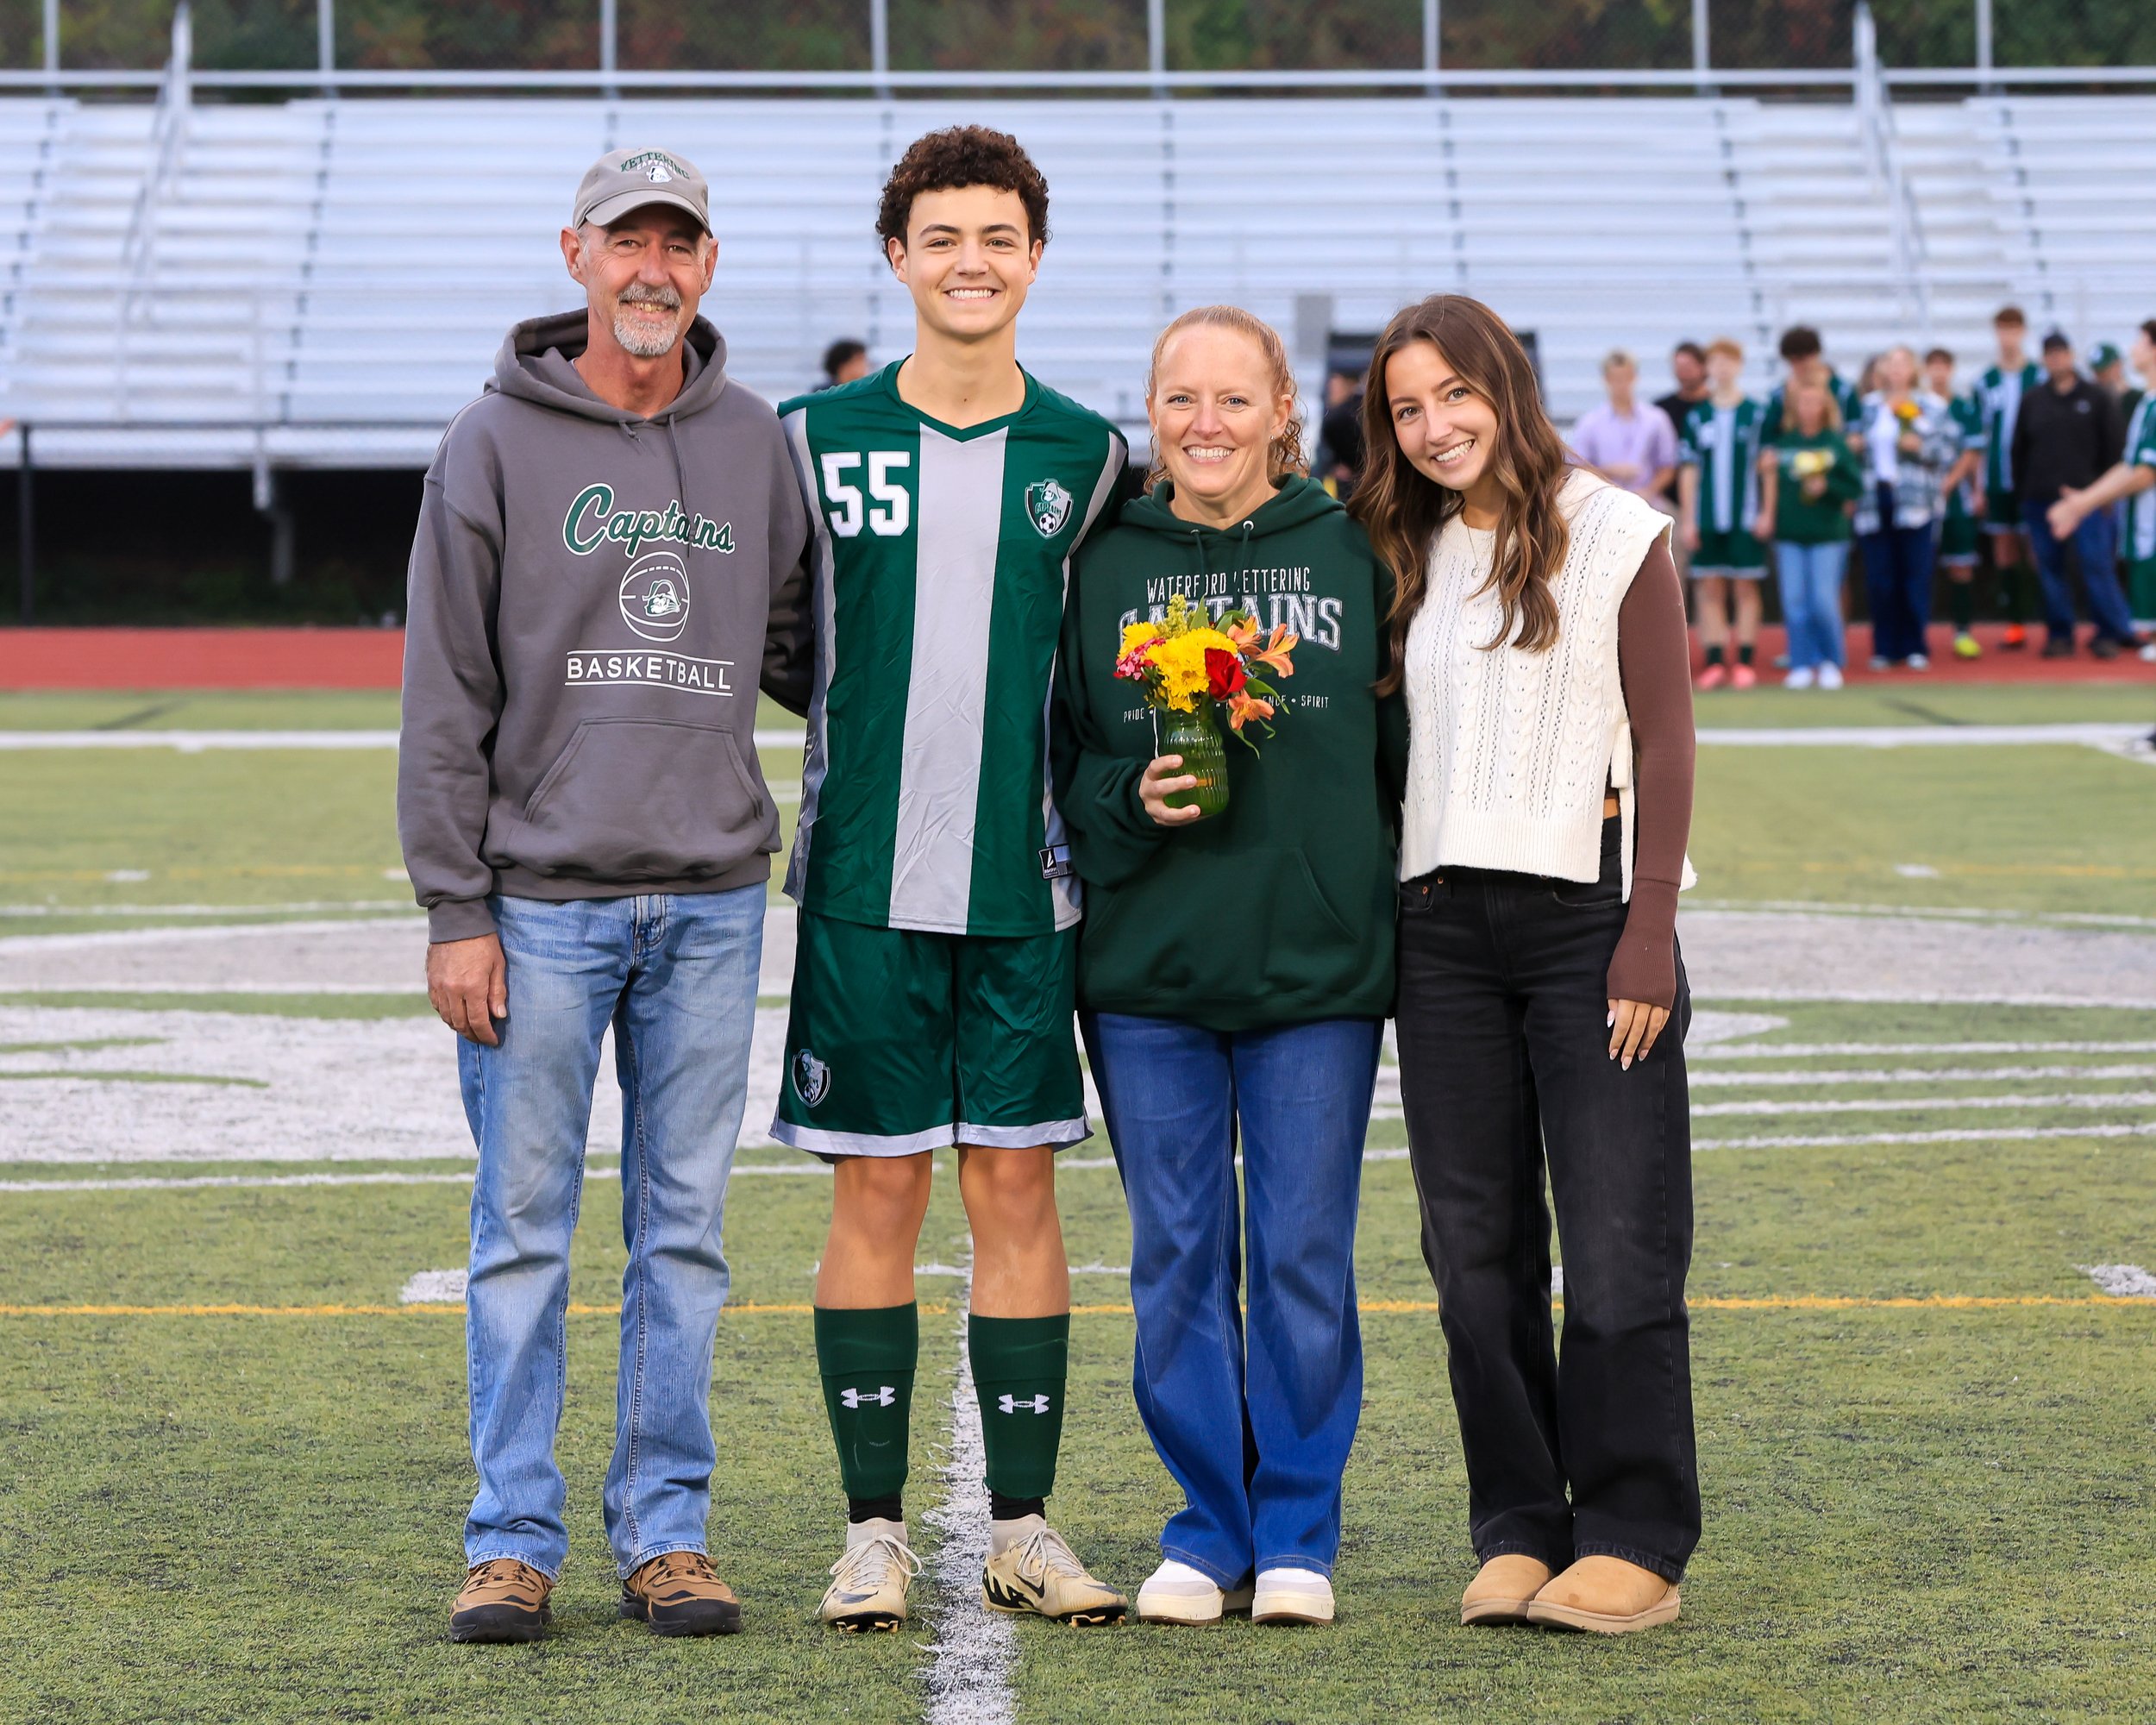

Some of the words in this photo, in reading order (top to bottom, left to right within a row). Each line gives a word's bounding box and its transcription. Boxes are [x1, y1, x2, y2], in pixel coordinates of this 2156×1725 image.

[820, 451, 910, 538] 55
[562, 482, 735, 559] Captains
[1233, 567, 1310, 593] ETTERING
[567, 656, 731, 689] BASKETBALL
[1123, 707, 1145, 724] PRIDE
[1300, 694, 1330, 708] SPIRIT
